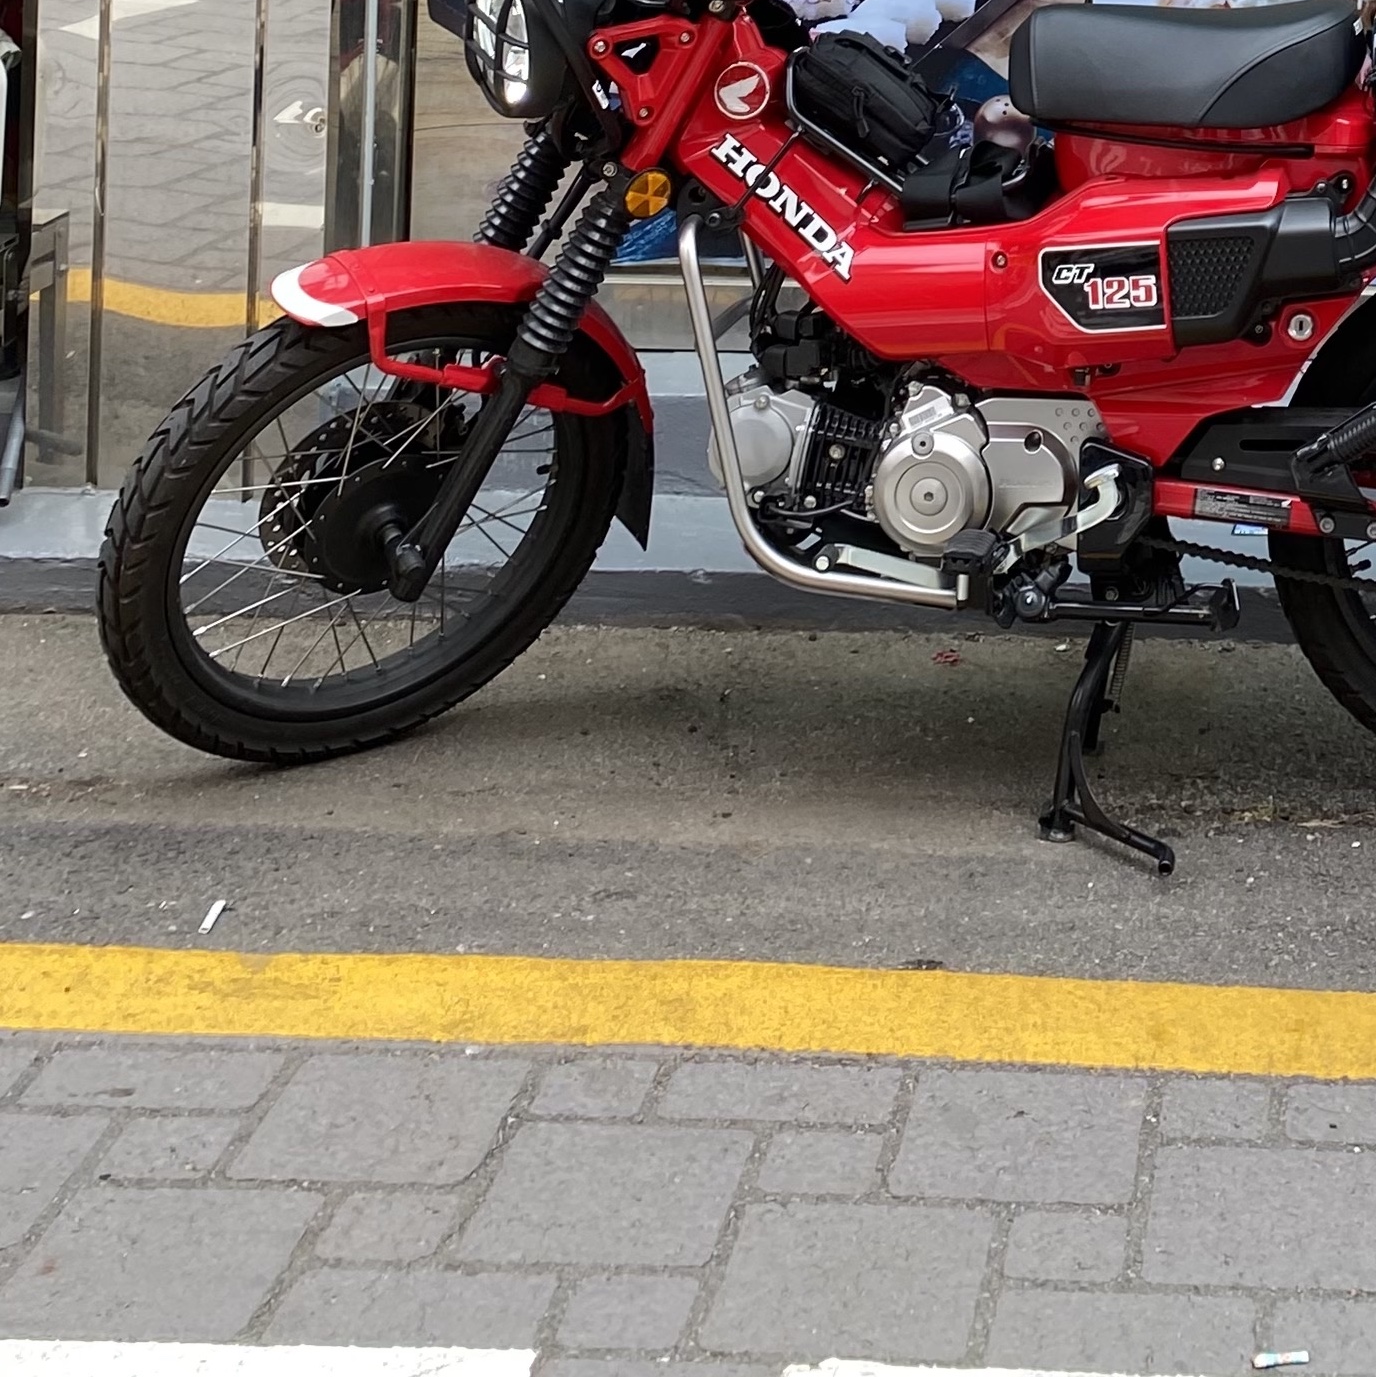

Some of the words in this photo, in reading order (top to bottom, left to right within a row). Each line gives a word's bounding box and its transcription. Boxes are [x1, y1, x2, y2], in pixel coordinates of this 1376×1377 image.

[710, 133, 855, 281] HONDA
[1052, 263, 1095, 284] CT
[1084, 274, 1158, 310] 125
